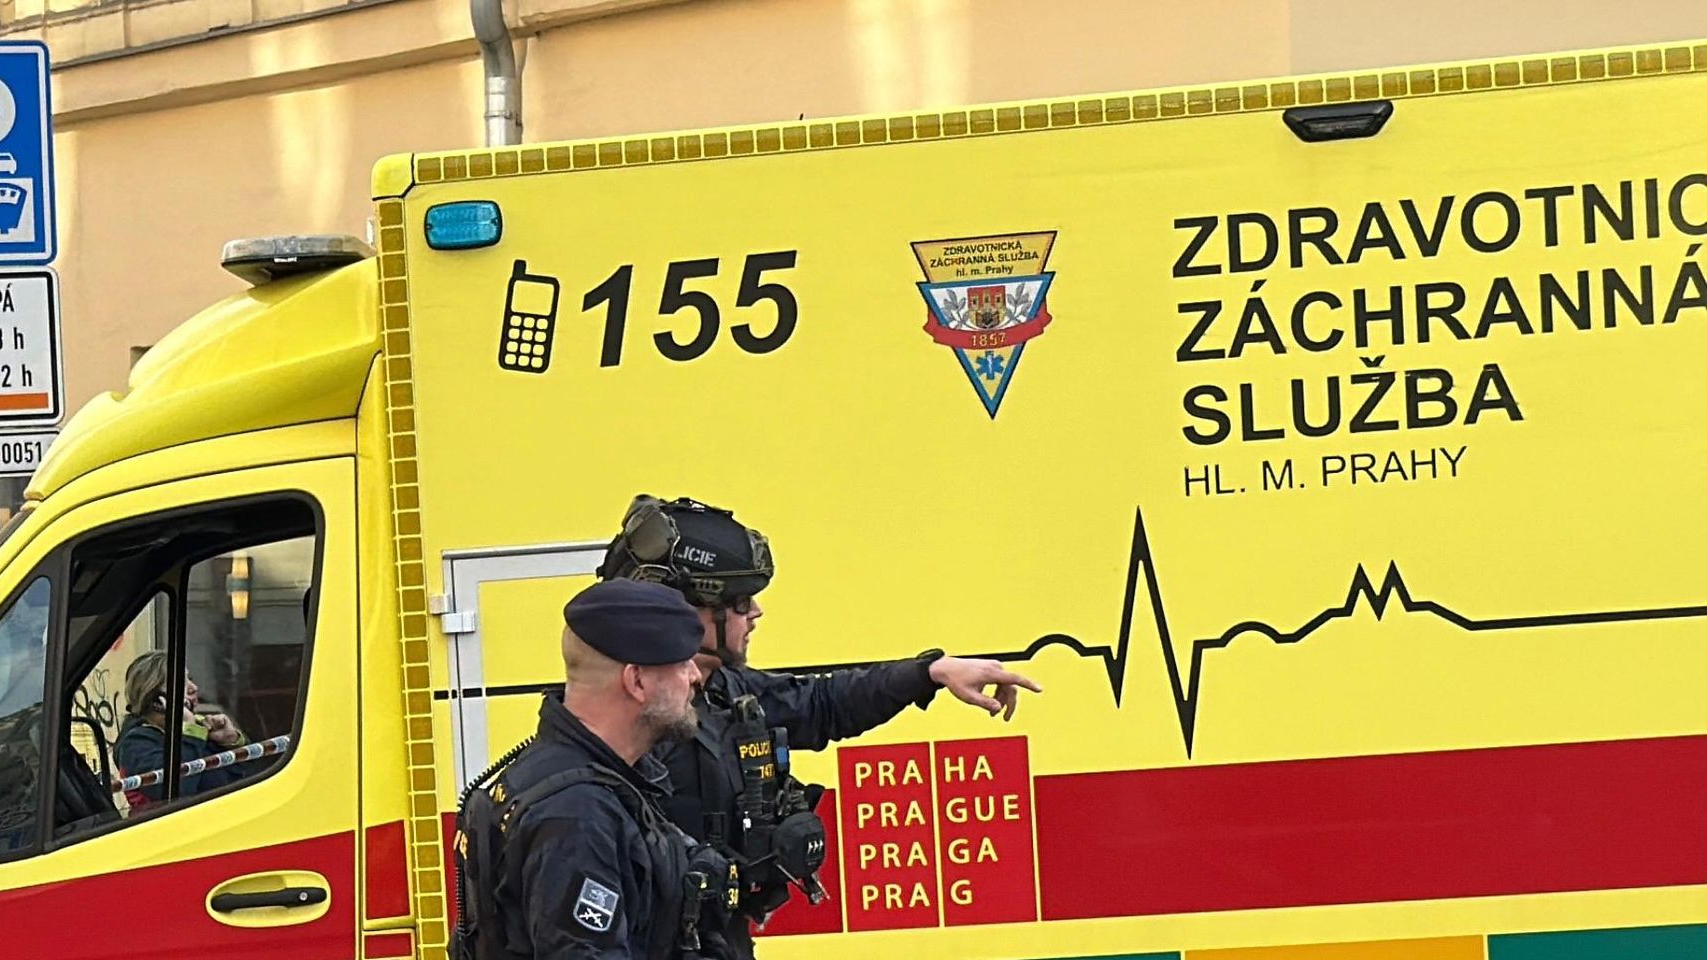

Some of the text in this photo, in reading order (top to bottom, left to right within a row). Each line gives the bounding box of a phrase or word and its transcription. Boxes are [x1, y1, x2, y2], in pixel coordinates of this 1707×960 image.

[985, 265, 1014, 275] Prahy
[582, 250, 798, 367] 155
[1176, 243, 1707, 362] ZÁCHRANNÁ
[13, 327, 24, 350] h
[971, 332, 1007, 347] 1857
[1, 364, 12, 388] 2
[22, 364, 33, 387] h
[1182, 355, 1524, 446] SLUŽBA
[1184, 446, 1467, 496] HL. M. PRAHY
[855, 755, 993, 788] PRA HA
[857, 794, 1020, 829] PRA GUE
[859, 837, 998, 870] PRA GA
[862, 879, 973, 910] PRA G
